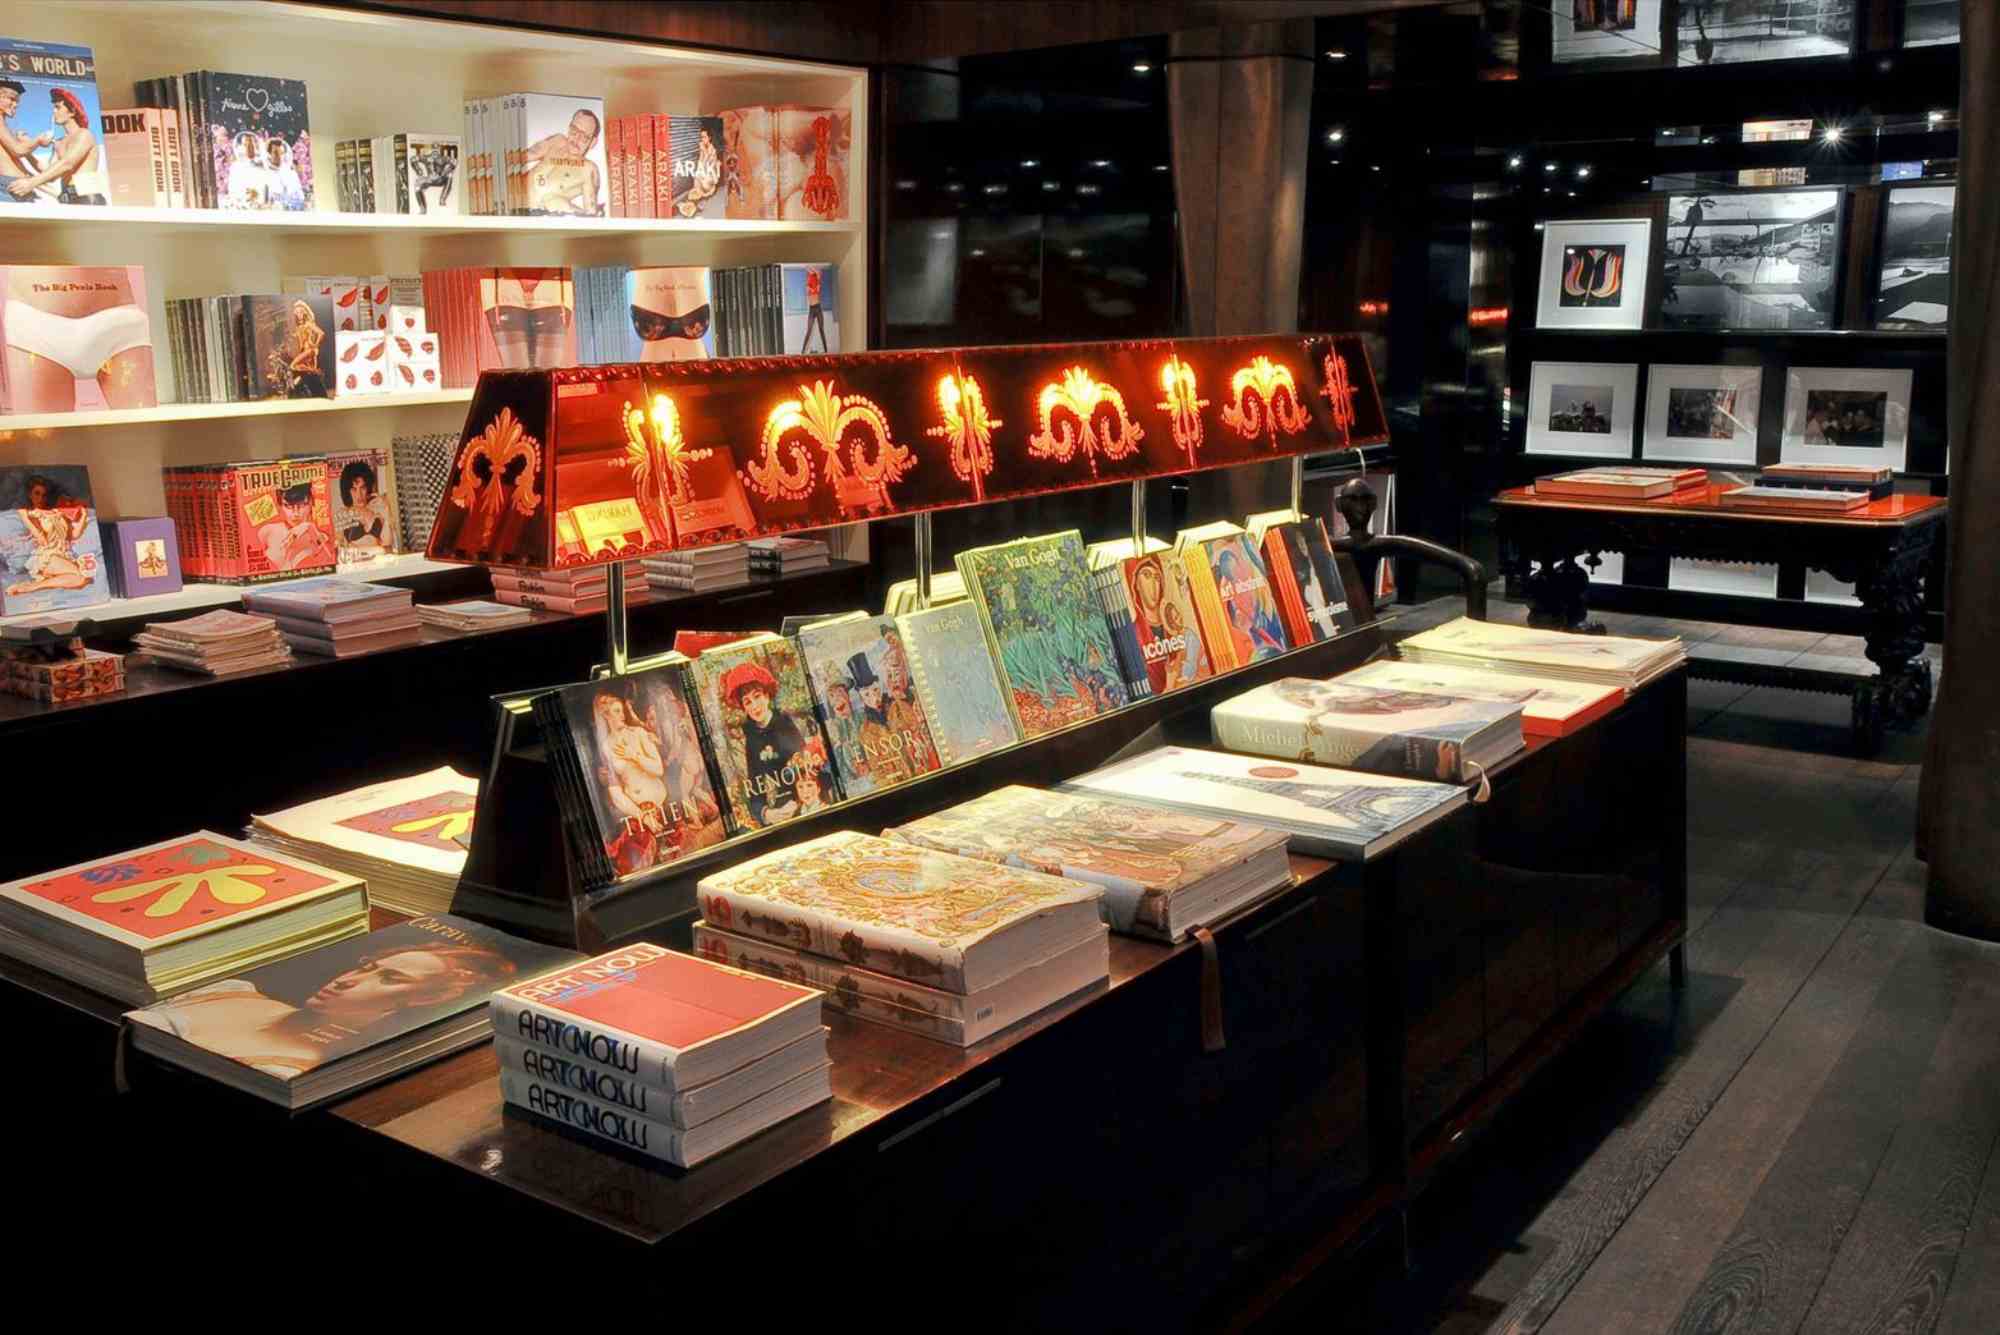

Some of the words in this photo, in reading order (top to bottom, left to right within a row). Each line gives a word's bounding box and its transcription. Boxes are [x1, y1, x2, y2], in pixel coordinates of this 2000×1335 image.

[31, 55, 86, 76] WORLD
[100, 113, 146, 134] OOK
[673, 159, 721, 177] ARAKI
[241, 470, 280, 491] TRUE
[1003, 553, 1031, 569] Van
[1029, 543, 1063, 568] Gogh
[855, 729, 919, 763] ENSOR
[743, 761, 818, 798] RENOIR
[620, 797, 700, 837] TITIEN
[518, 975, 583, 1001] ART
[581, 946, 666, 979] NOW
